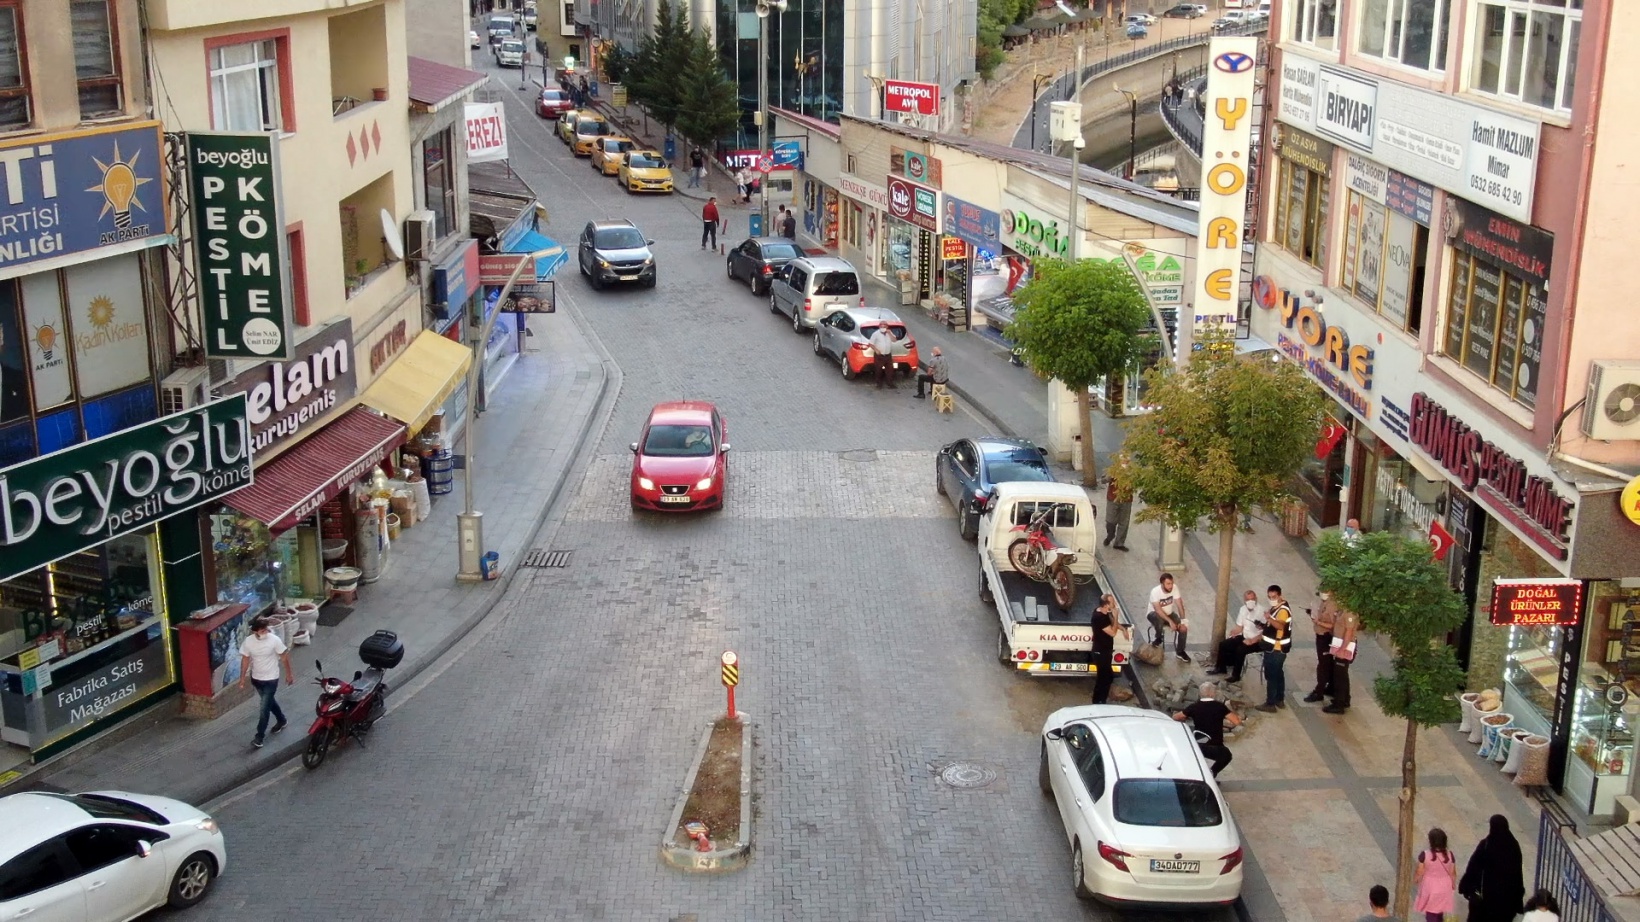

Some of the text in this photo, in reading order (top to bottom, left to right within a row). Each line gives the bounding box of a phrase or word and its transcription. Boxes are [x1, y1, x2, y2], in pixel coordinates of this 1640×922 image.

[887, 85, 932, 99] METROPOL
[1326, 91, 1373, 136] BİRYAPI
[465, 107, 504, 156] EREZİ
[1471, 120, 1496, 146] Hamit
[1496, 127, 1535, 160] MAZLUM
[197, 148, 268, 169] beyoğlu
[1281, 144, 1327, 174] MÜHENDİSLİK
[1487, 155, 1510, 179] Mimar
[869, 189, 888, 206] GÜMÜ
[891, 186, 910, 207] kale
[1204, 97, 1248, 301] YÖRE
[1470, 176, 1523, 206] 0532 685 42 90
[100, 231, 116, 245] AK
[1488, 216, 1521, 243] EMİN
[236, 176, 272, 314] KÖME
[203, 176, 238, 350] PESTİL
[1194, 312, 1238, 324] PESTİL
[1277, 288, 1375, 390] YÖRE
[249, 338, 349, 425] elam
[0, 409, 248, 545] beyoğlu
[1409, 390, 1483, 492] GÜMÜŞ
[1524, 474, 1576, 544] KÖME
[107, 462, 251, 537] pestil köme
[294, 491, 327, 521] SELAM
[1510, 598, 1562, 611] ÜRÜNLER
[1517, 587, 1557, 598] DOĞAL
[75, 614, 103, 638] pestil
[1513, 613, 1556, 623] PAZARI
[1039, 634, 1095, 642] KIA MOTO
[57, 675, 108, 708] Fabrika
[110, 658, 145, 683] Satış
[69, 683, 137, 724] Mağazası
[1154, 860, 1199, 871] 34DAD777
